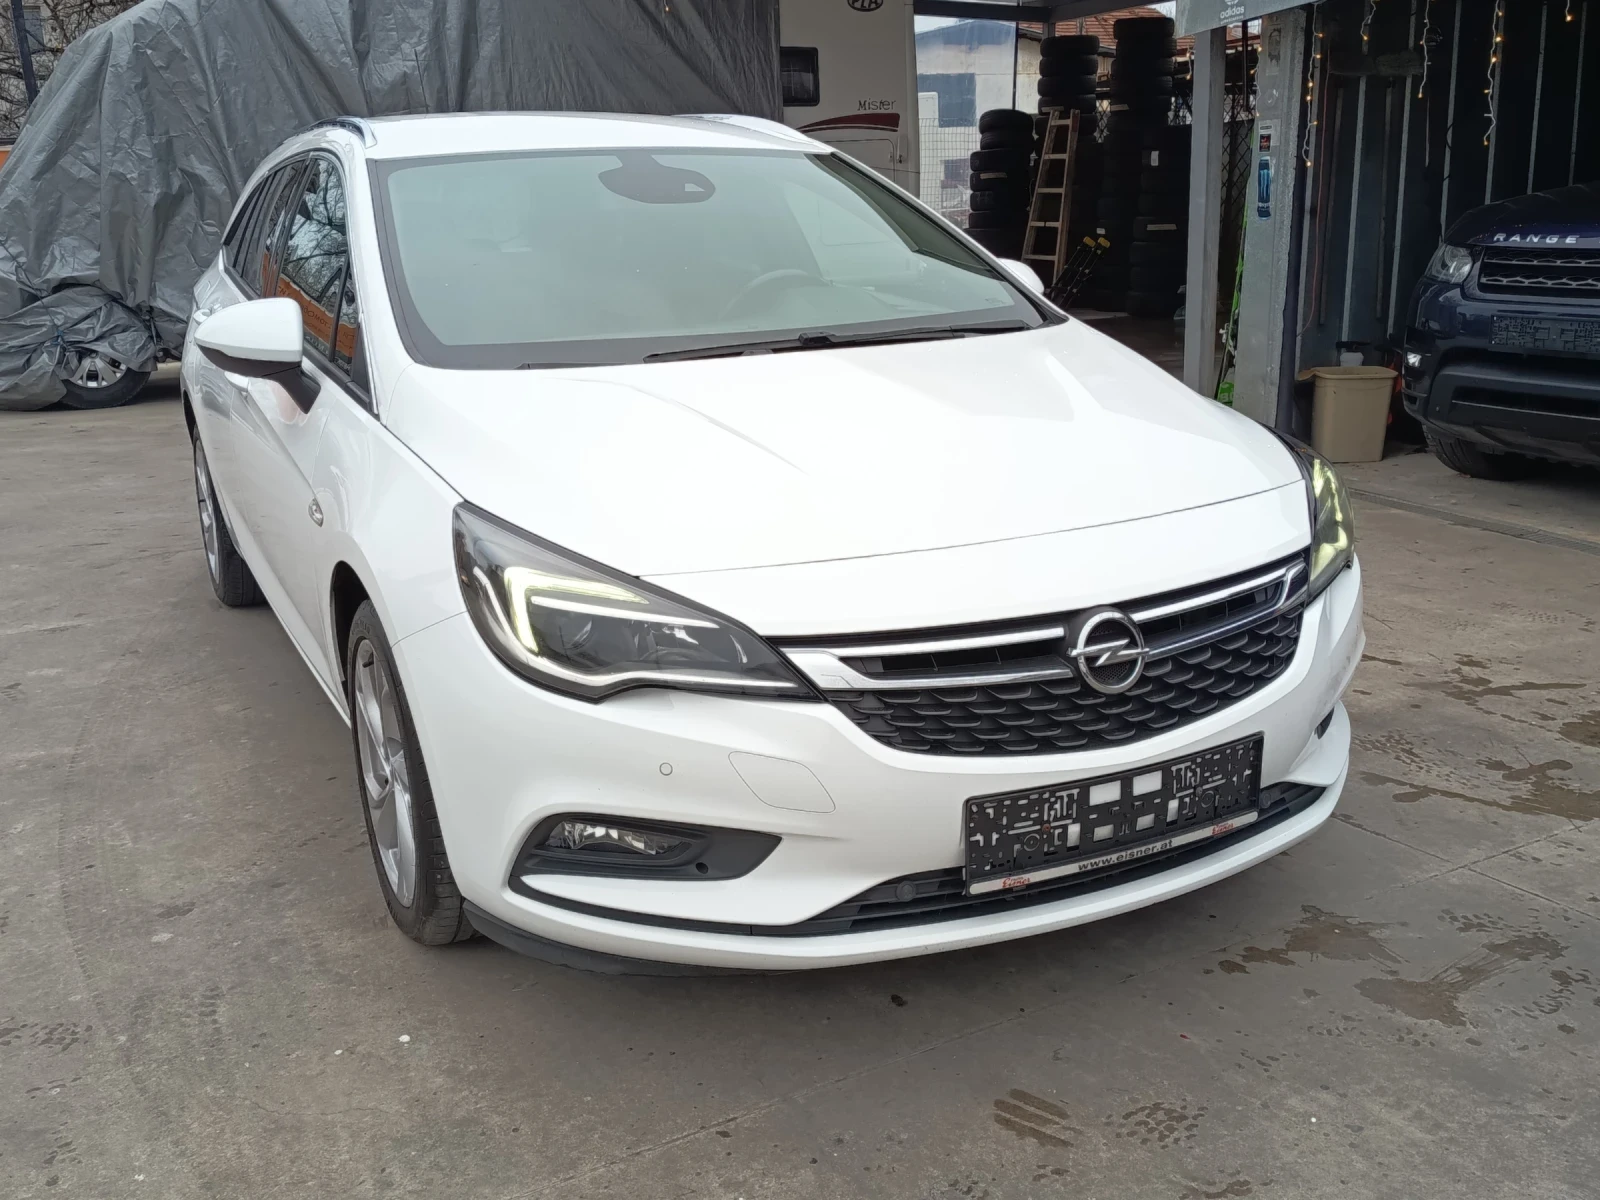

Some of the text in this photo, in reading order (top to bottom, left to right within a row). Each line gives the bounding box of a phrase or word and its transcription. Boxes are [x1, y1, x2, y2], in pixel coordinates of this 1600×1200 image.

[1220, 5, 1245, 19] adidas
[857, 97, 897, 111] Mister
[1493, 233, 1580, 244] RANGE
[1078, 839, 1174, 871] www.eisner.at
